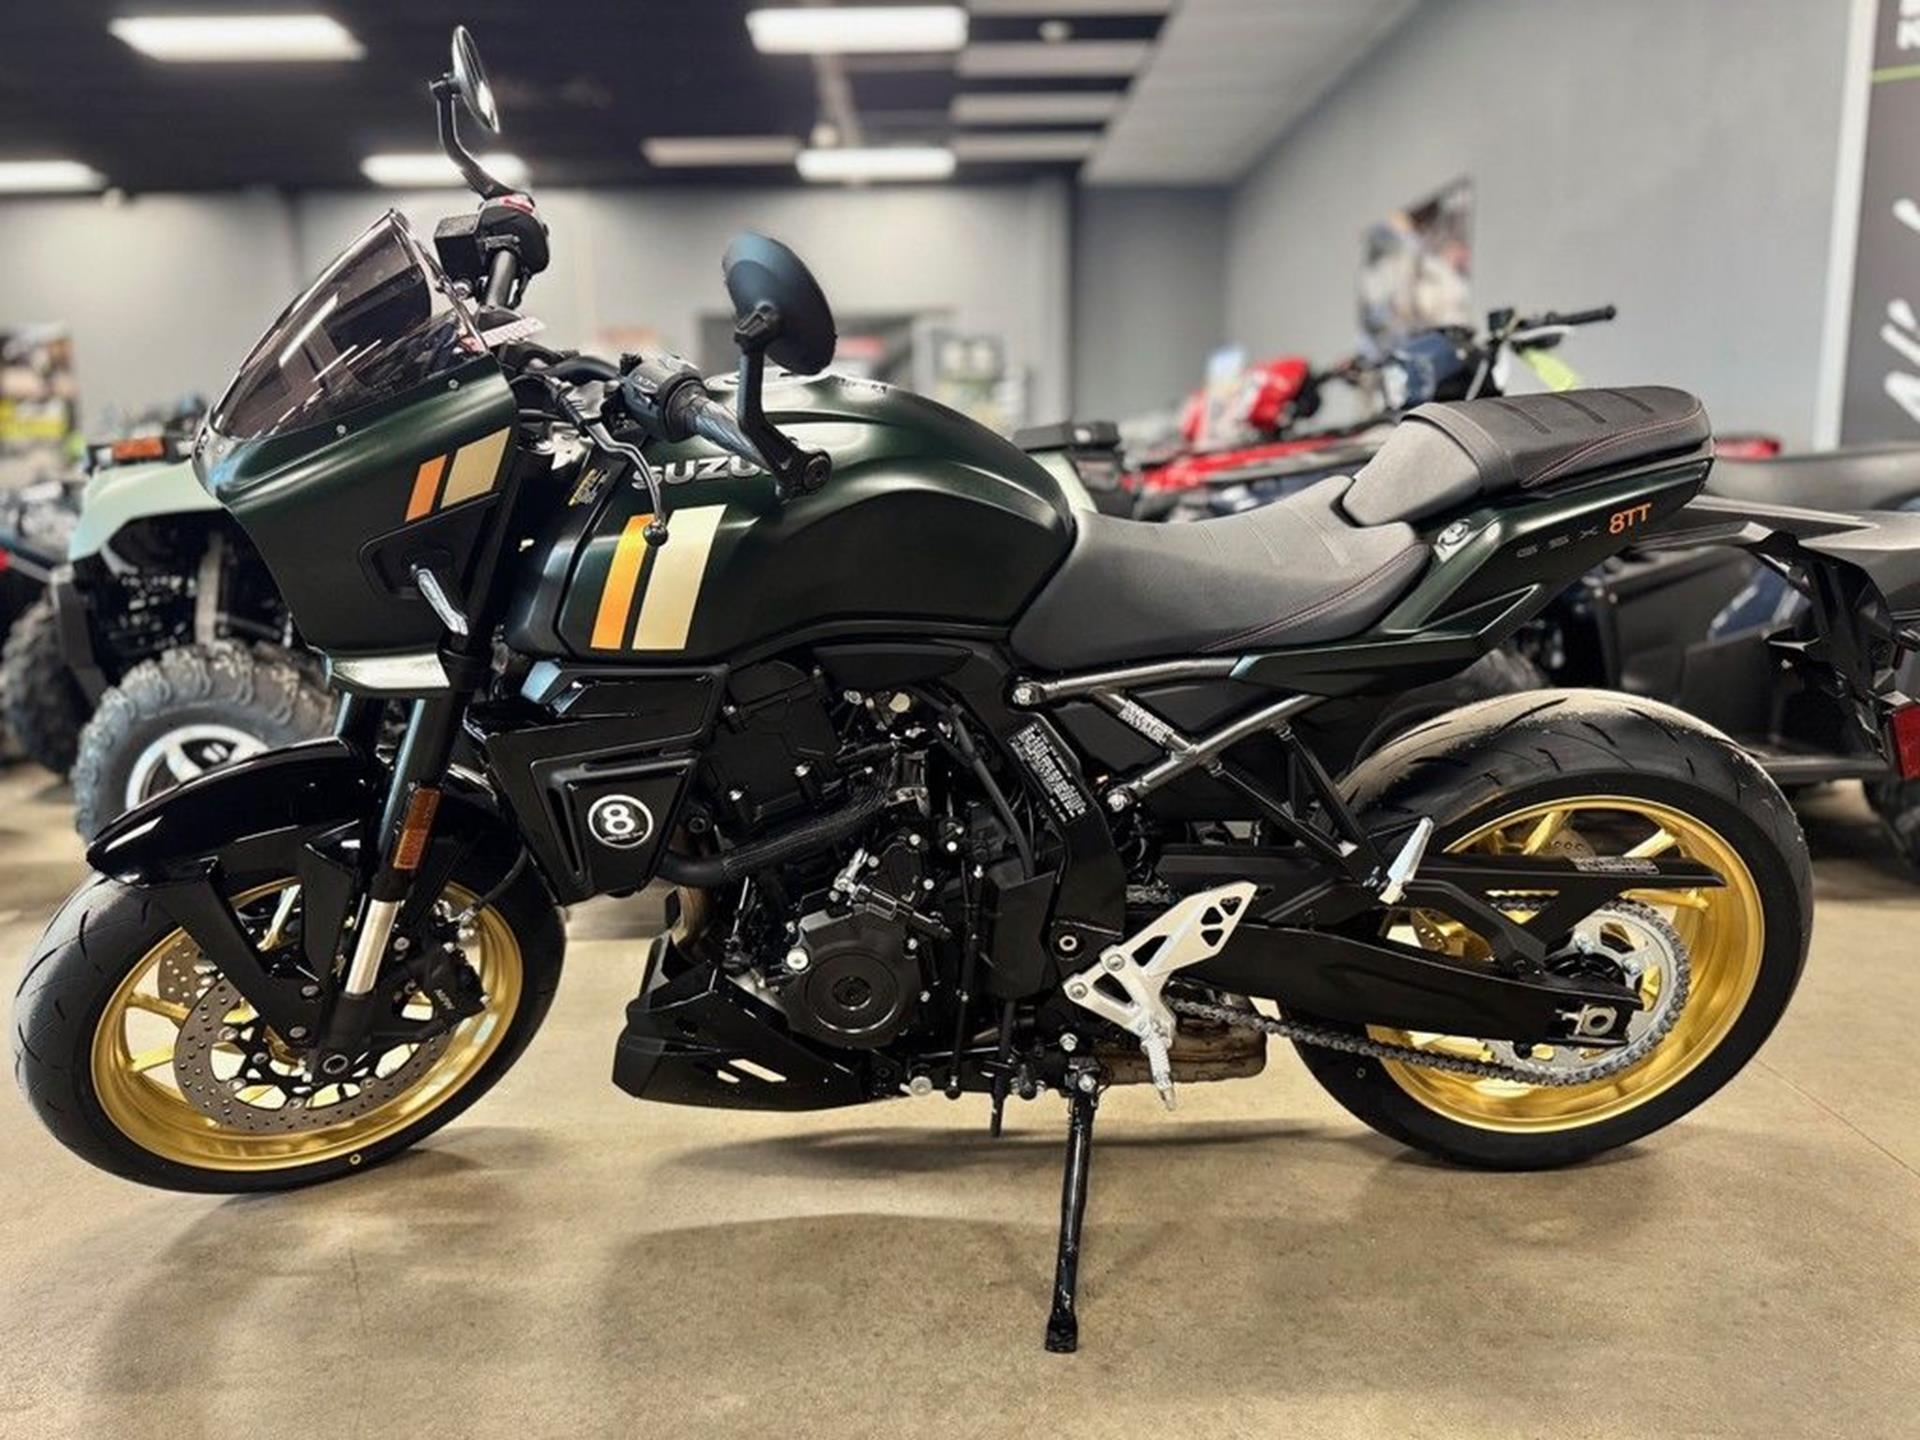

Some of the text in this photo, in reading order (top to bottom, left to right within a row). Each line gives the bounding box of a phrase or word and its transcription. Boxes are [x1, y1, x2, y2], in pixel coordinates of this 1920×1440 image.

[631, 455, 773, 491] SUZU
[1609, 502, 1652, 534] 8TT
[602, 803, 635, 835] 8
